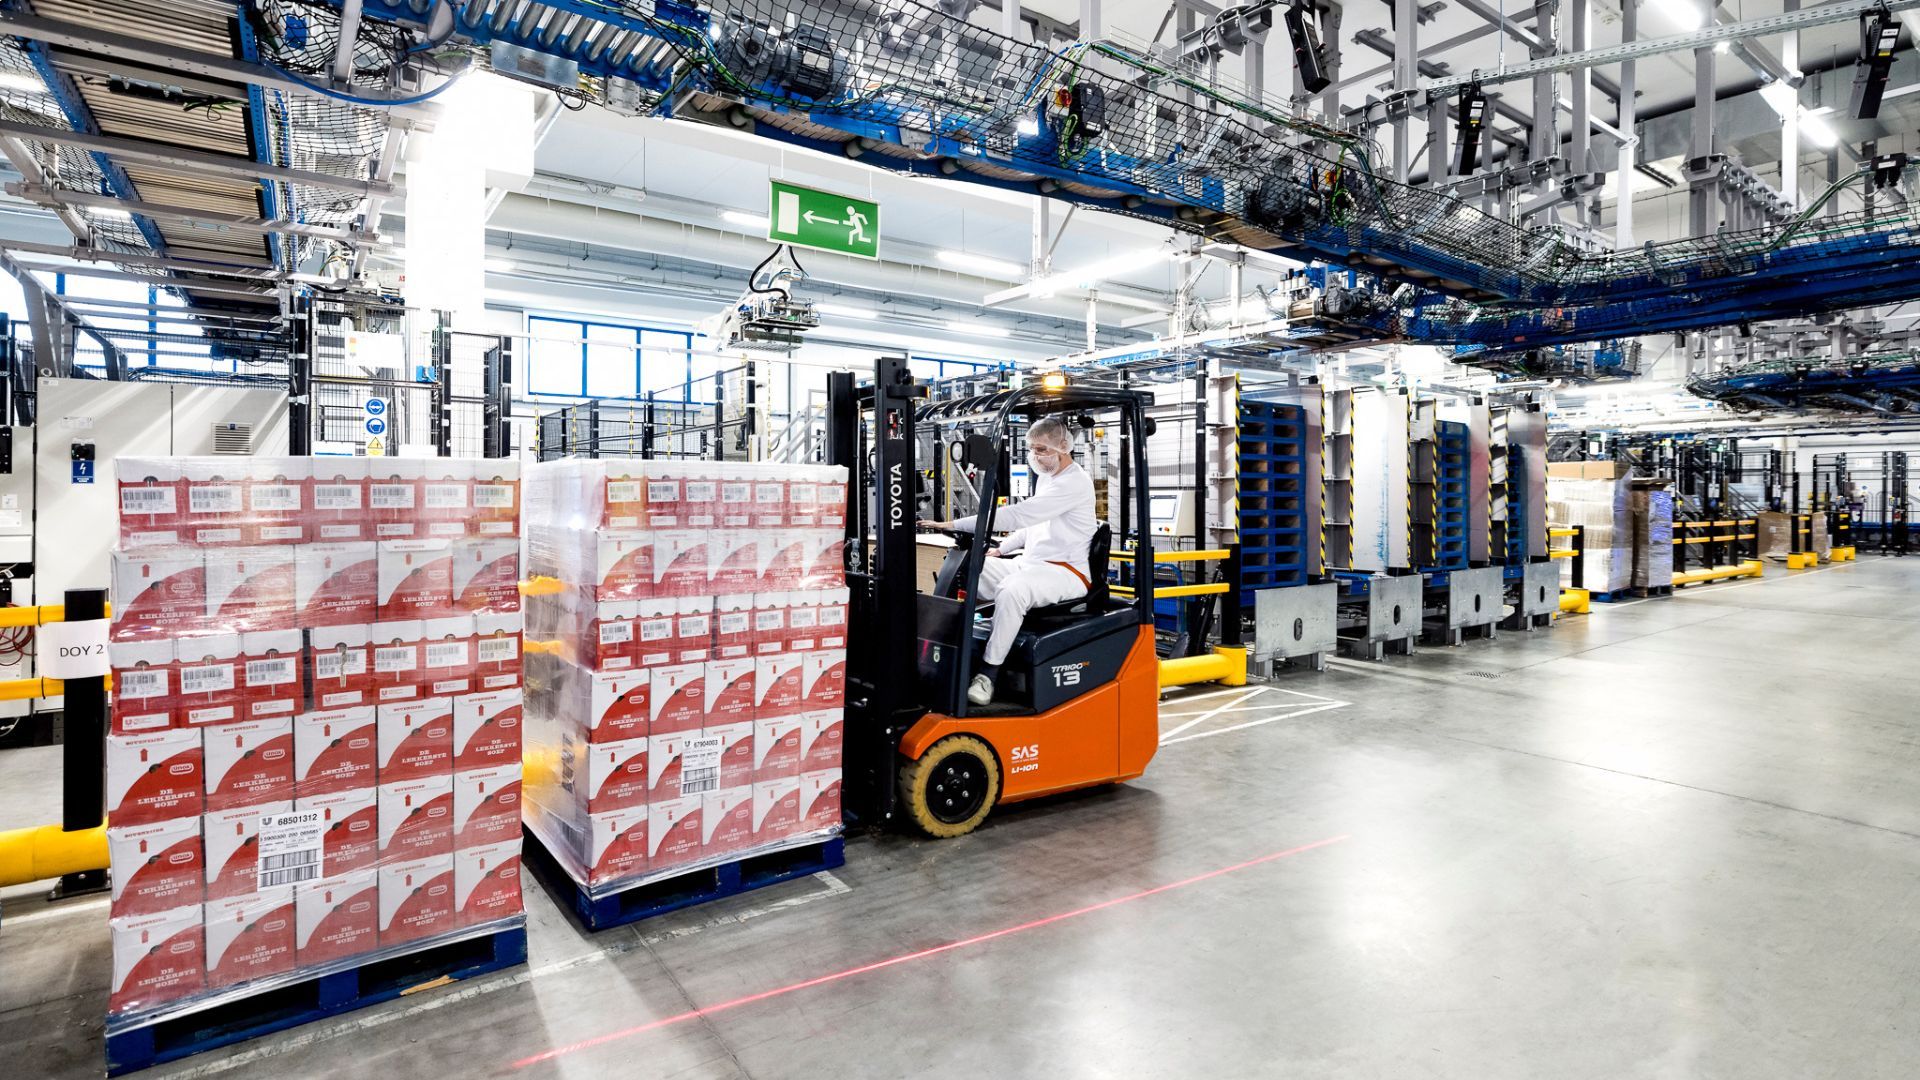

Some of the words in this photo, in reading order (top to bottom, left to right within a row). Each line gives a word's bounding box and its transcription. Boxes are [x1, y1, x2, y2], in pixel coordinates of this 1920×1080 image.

[891, 463, 902, 529] TOYOTA
[60, 646, 91, 657] DOY
[96, 644, 104, 654] 2
[1054, 670, 1080, 687] 13
[1011, 744, 1038, 760] SAS
[401, 753, 446, 764] LEKKERSTE
[233, 776, 286, 788] LEKKERSTE
[138, 792, 195, 804] LEKKERSTE
[155, 800, 178, 808] SOEP
[278, 814, 318, 826] 68501312
[138, 880, 195, 895] LEKKERSTE
[155, 889, 179, 897] SOEP
[138, 969, 196, 986] LEKKERSTE
